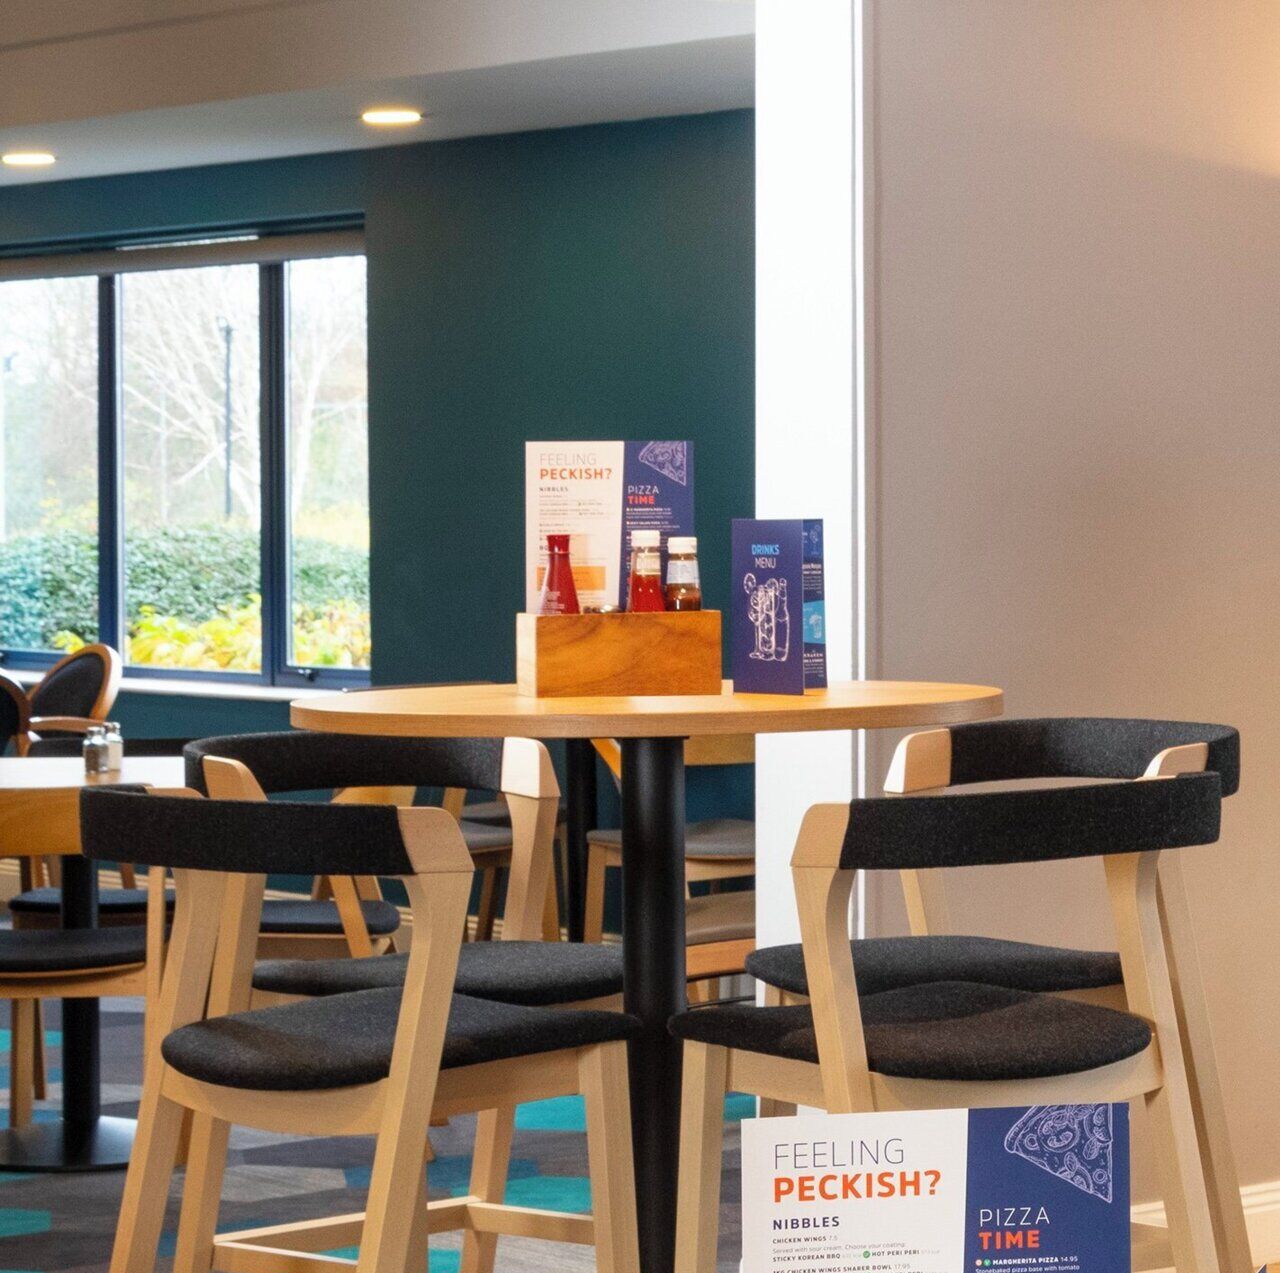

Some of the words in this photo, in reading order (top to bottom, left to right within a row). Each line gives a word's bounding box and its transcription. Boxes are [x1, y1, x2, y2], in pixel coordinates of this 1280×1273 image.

[539, 453, 597, 466] FEELING
[539, 467, 612, 480] PECKISH?
[627, 485, 660, 494] PIZZA
[627, 495, 656, 504] TIME
[751, 544, 780, 556] DRINKS
[755, 557, 777, 569] MENU
[774, 1138, 904, 1170] FEELING
[774, 1169, 941, 1203] PECKISH?
[980, 1206, 1051, 1227] PIZZA
[772, 1216, 841, 1231] NIBBLES
[772, 1237, 802, 1245] CHICKEN
[978, 1230, 1040, 1250] TIME
[798, 1253, 825, 1261] KOREAN
[992, 1258, 1037, 1266] MARGHERITA
